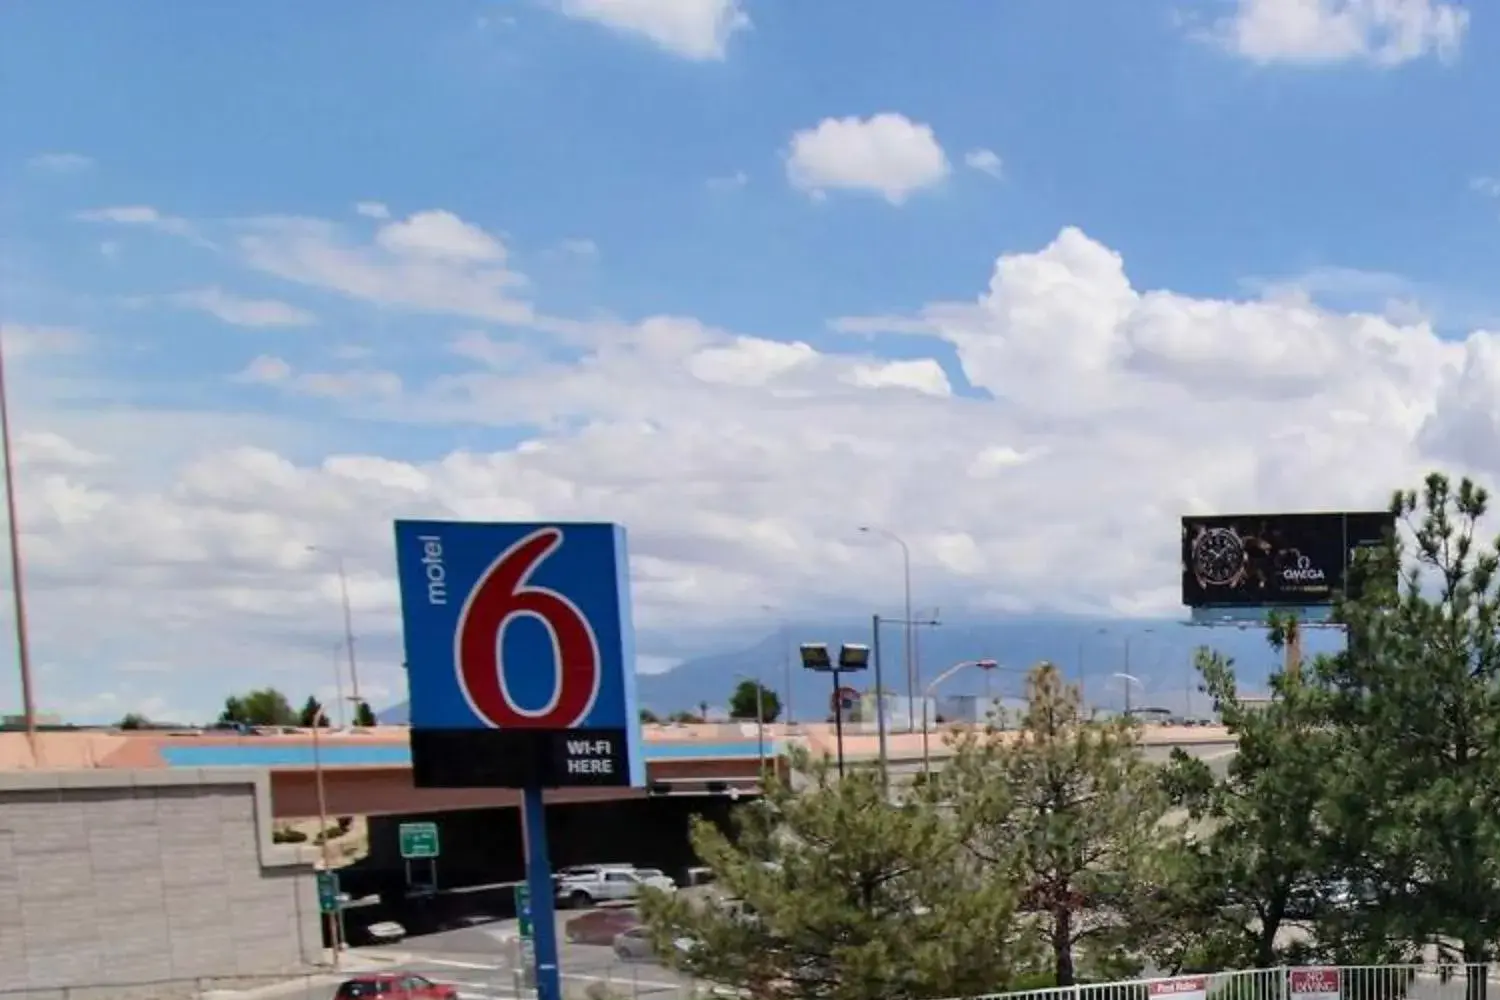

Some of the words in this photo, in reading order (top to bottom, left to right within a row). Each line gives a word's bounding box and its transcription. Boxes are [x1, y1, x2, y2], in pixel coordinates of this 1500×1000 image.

[417, 535, 448, 606] motel
[1283, 569, 1325, 580] OMEGA
[453, 526, 601, 730] 6
[566, 740, 612, 756] WI-FI
[567, 759, 613, 773] HERE
